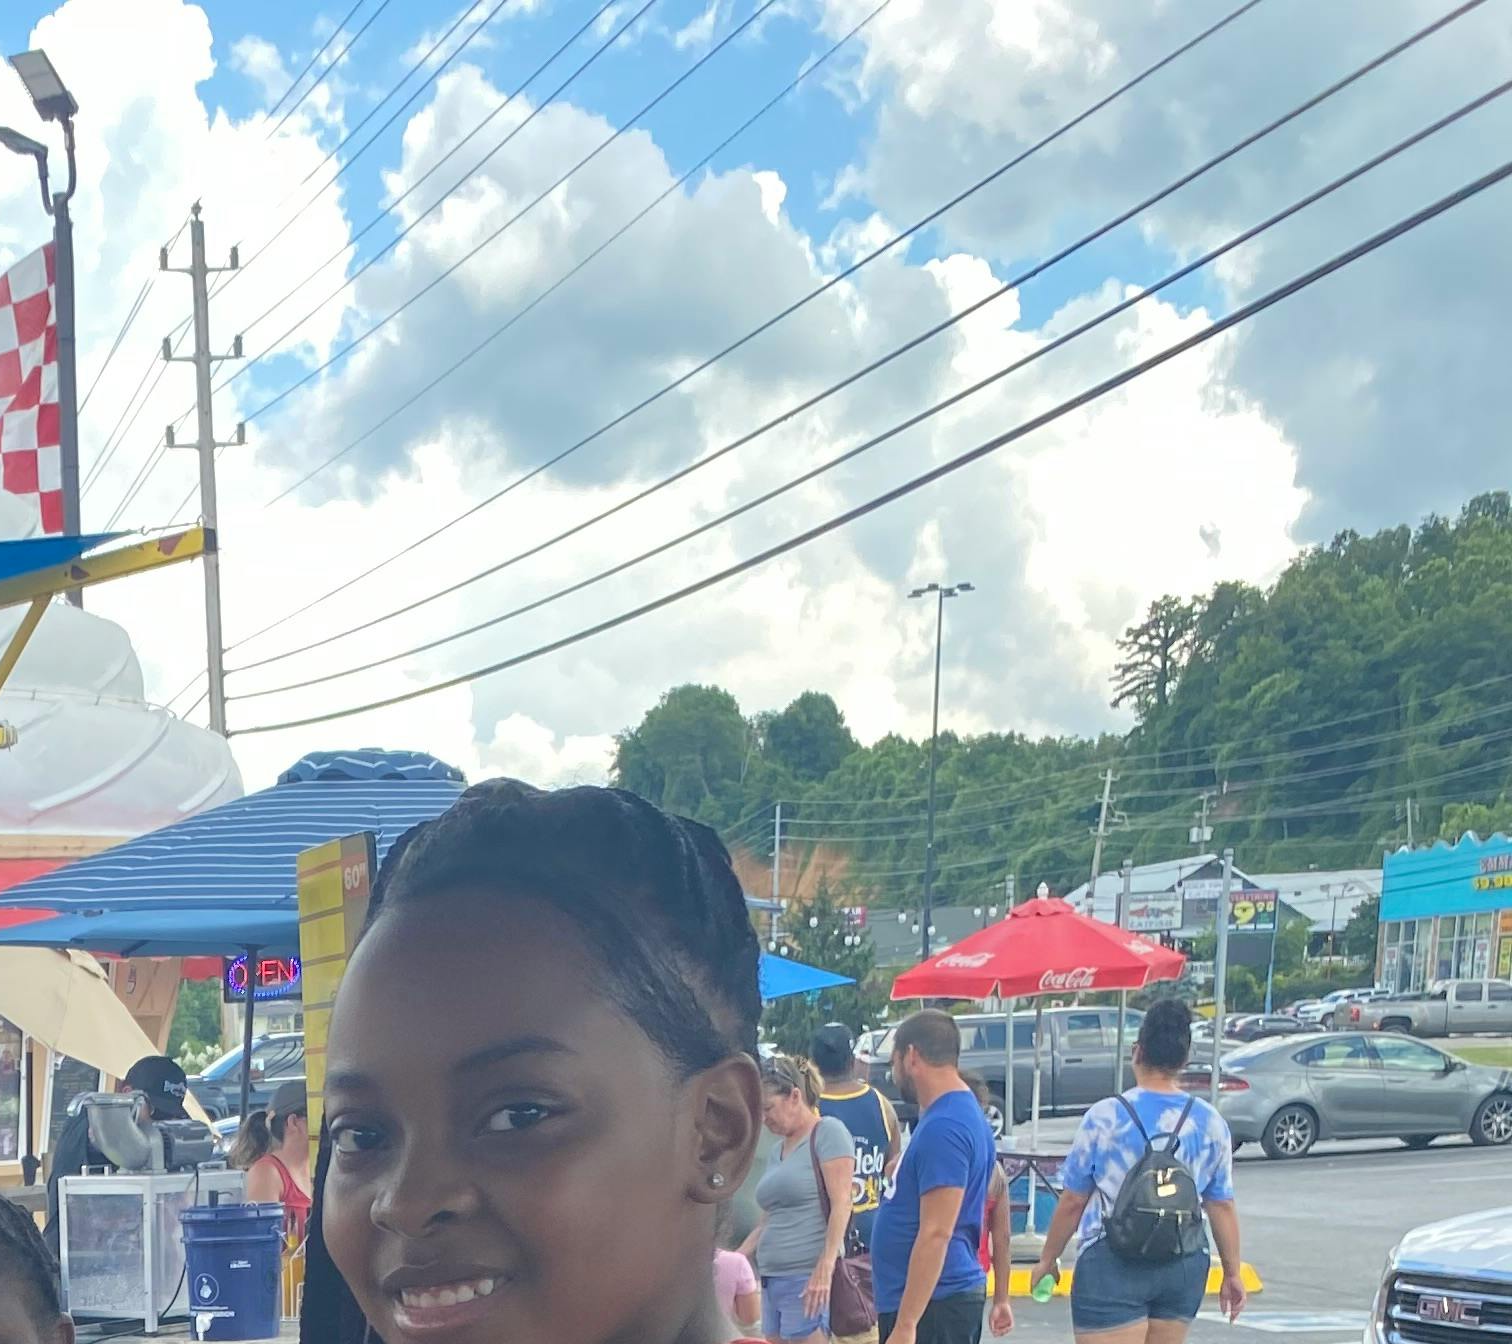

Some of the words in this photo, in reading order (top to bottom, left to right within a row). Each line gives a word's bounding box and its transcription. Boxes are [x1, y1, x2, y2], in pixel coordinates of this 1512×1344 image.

[343, 863, 366, 890] 60"
[229, 958, 295, 989] OEN
[1417, 1294, 1482, 1325] GMC
